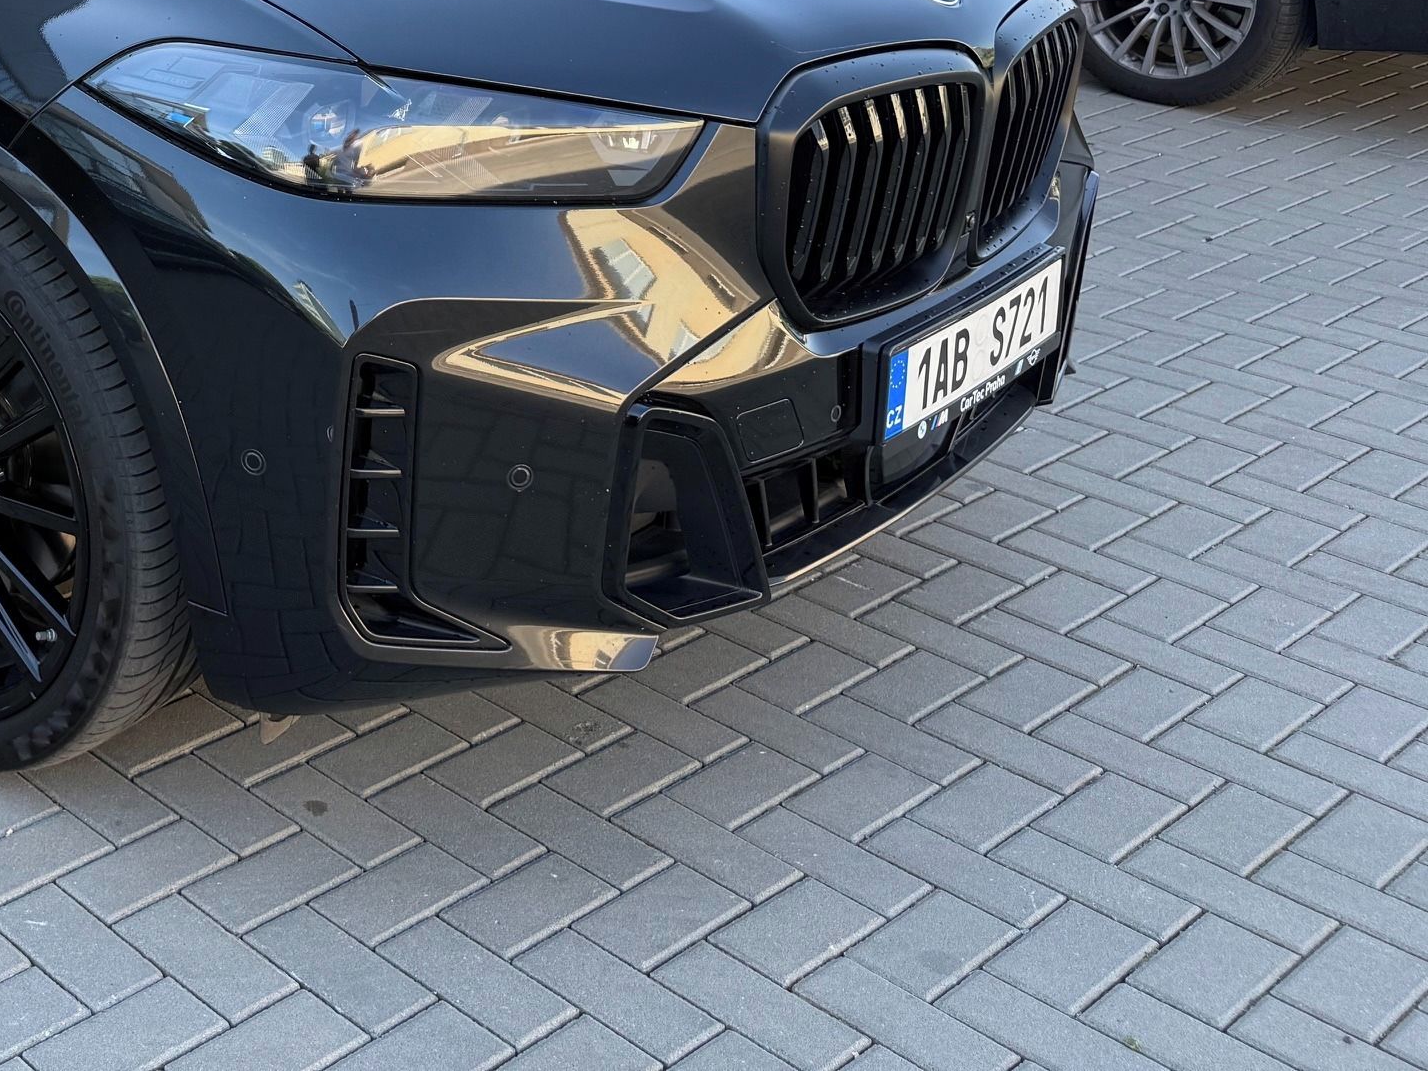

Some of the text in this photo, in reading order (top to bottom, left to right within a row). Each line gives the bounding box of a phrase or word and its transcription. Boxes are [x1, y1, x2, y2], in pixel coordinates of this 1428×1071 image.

[3, 290, 88, 427] Continental
[918, 275, 1049, 410] 1AB S721
[886, 405, 903, 429] CZ
[960, 374, 1006, 413] CarTec Praha
